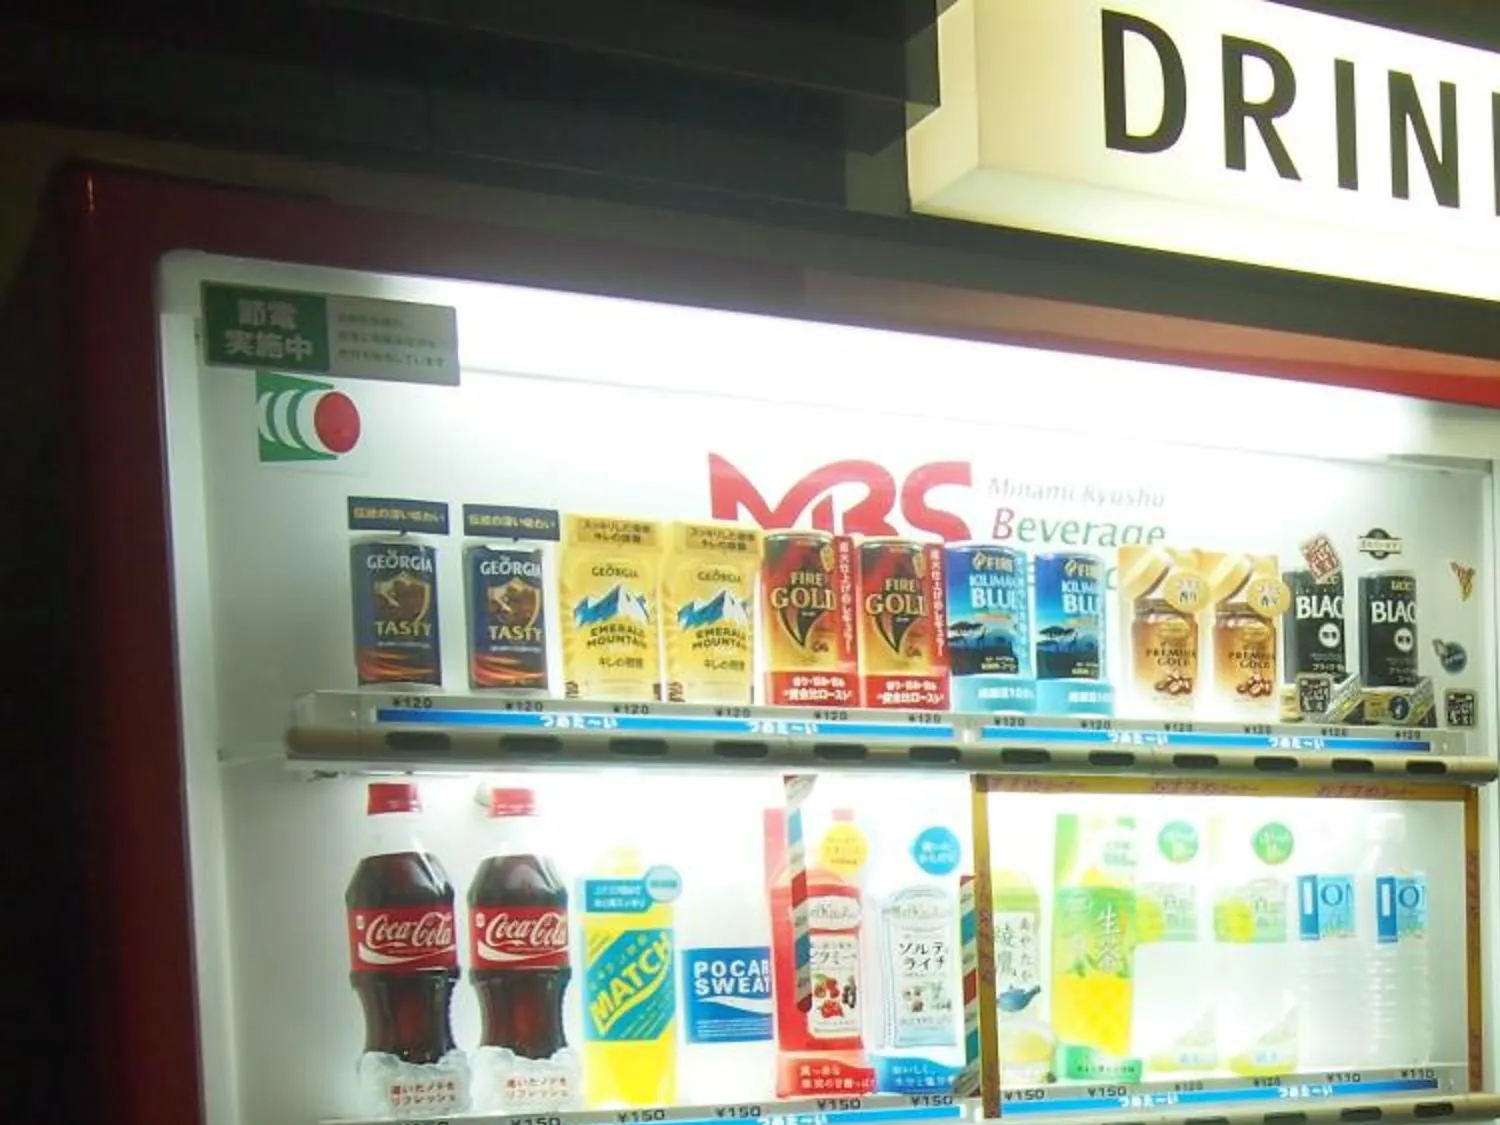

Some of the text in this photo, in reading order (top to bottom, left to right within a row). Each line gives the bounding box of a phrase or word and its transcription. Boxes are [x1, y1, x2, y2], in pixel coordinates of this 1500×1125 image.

[1082, 483, 1166, 510] Kyushu
[992, 507, 1166, 549] Beverage
[789, 571, 824, 586] FIRE
[885, 579, 916, 593] FIRE
[375, 620, 433, 637] TASTY
[488, 624, 542, 641] TASTY
[365, 911, 455, 949] Coca-Cola
[485, 912, 569, 948] Coca-Cola
[1097, 901, 1123, 975] 生茶
[591, 932, 673, 1036] MATCH
[1325, 1072, 1362, 1084] ¥110
[1400, 1069, 1435, 1081] ¥110
[1003, 1089, 1045, 1102] ¥150
[1087, 1086, 1127, 1099] ¥150
[816, 1097, 862, 1112] ¥150
[910, 1094, 954, 1108] ¥150
[617, 1109, 666, 1125] ¥150
[715, 1105, 762, 1119] ¥150
